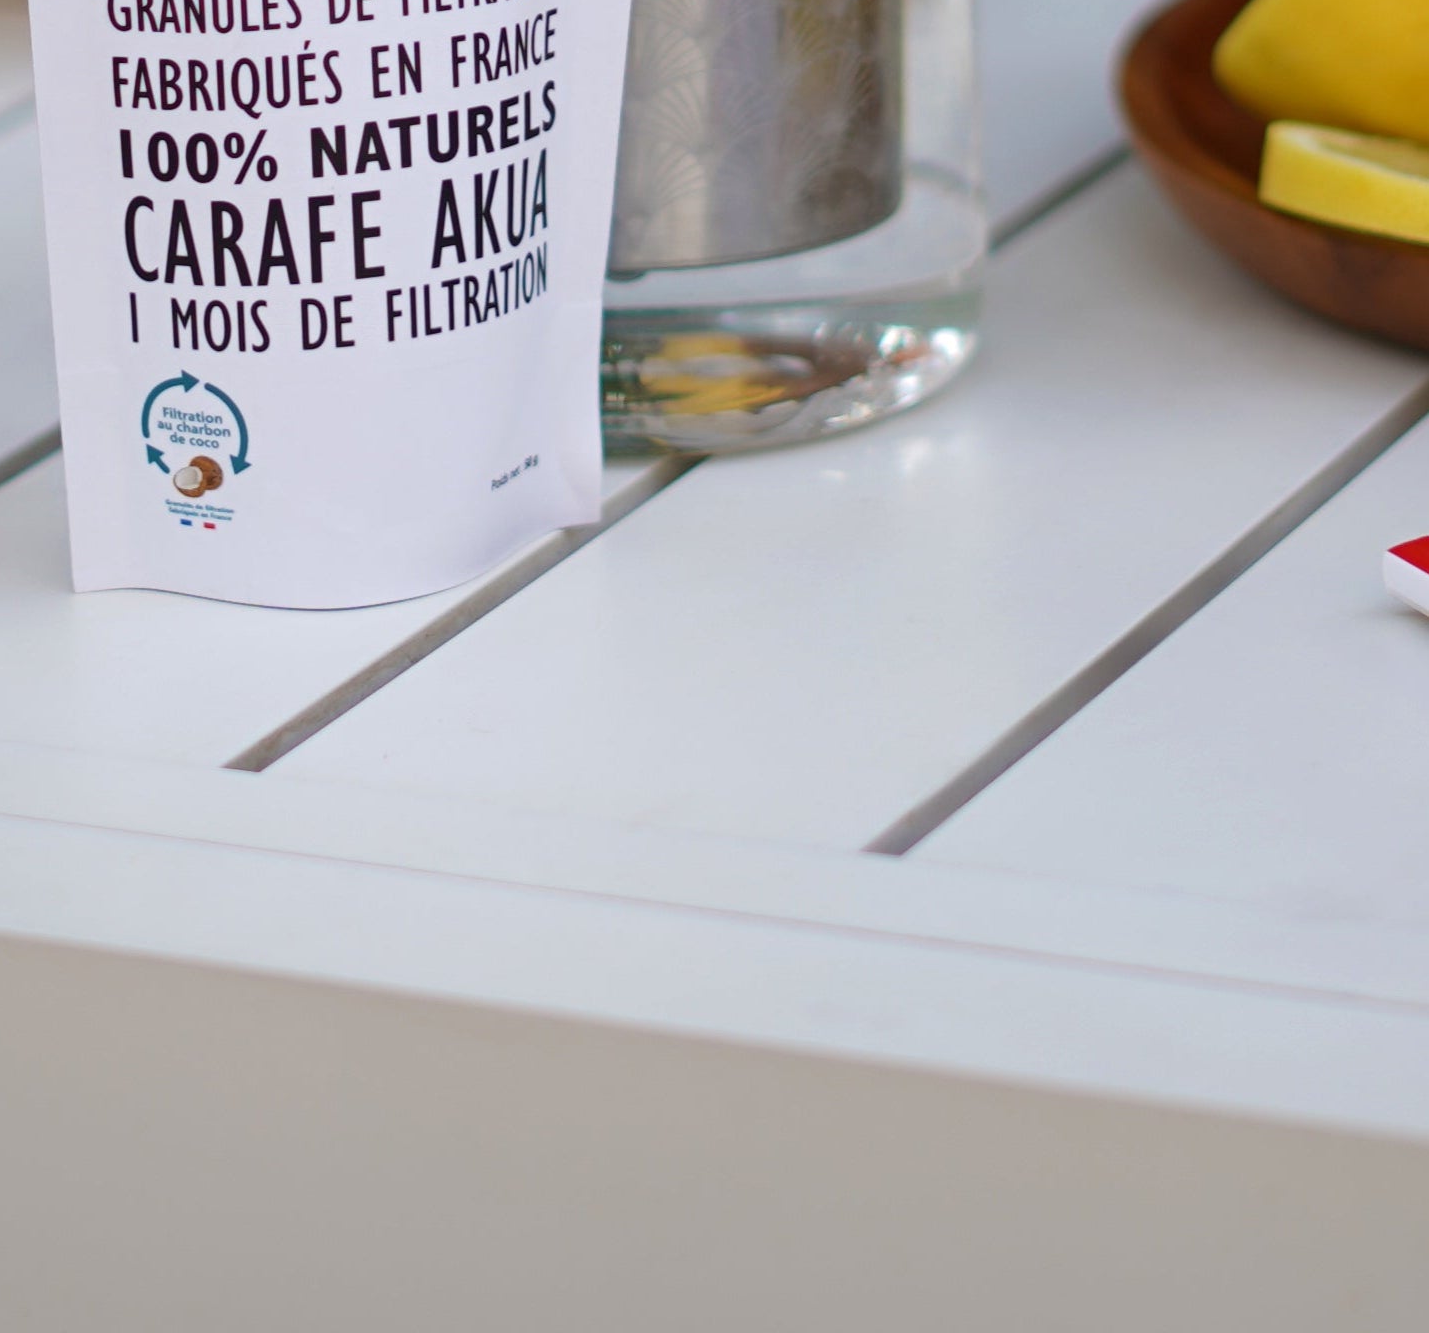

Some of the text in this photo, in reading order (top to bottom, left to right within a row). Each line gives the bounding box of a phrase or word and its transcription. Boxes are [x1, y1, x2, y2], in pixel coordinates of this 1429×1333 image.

[112, 8, 558, 120] FABRIQUÉS EN FRANCE
[119, 80, 556, 185] 100% NATURELS
[124, 148, 548, 287] CARAFE AKUA
[170, 297, 270, 353] MOIS
[300, 294, 356, 351] DE
[386, 242, 547, 342] FILTRATION
[157, 420, 232, 437] au charbon
[162, 407, 223, 424] Filtration
[170, 432, 220, 449] de coco
